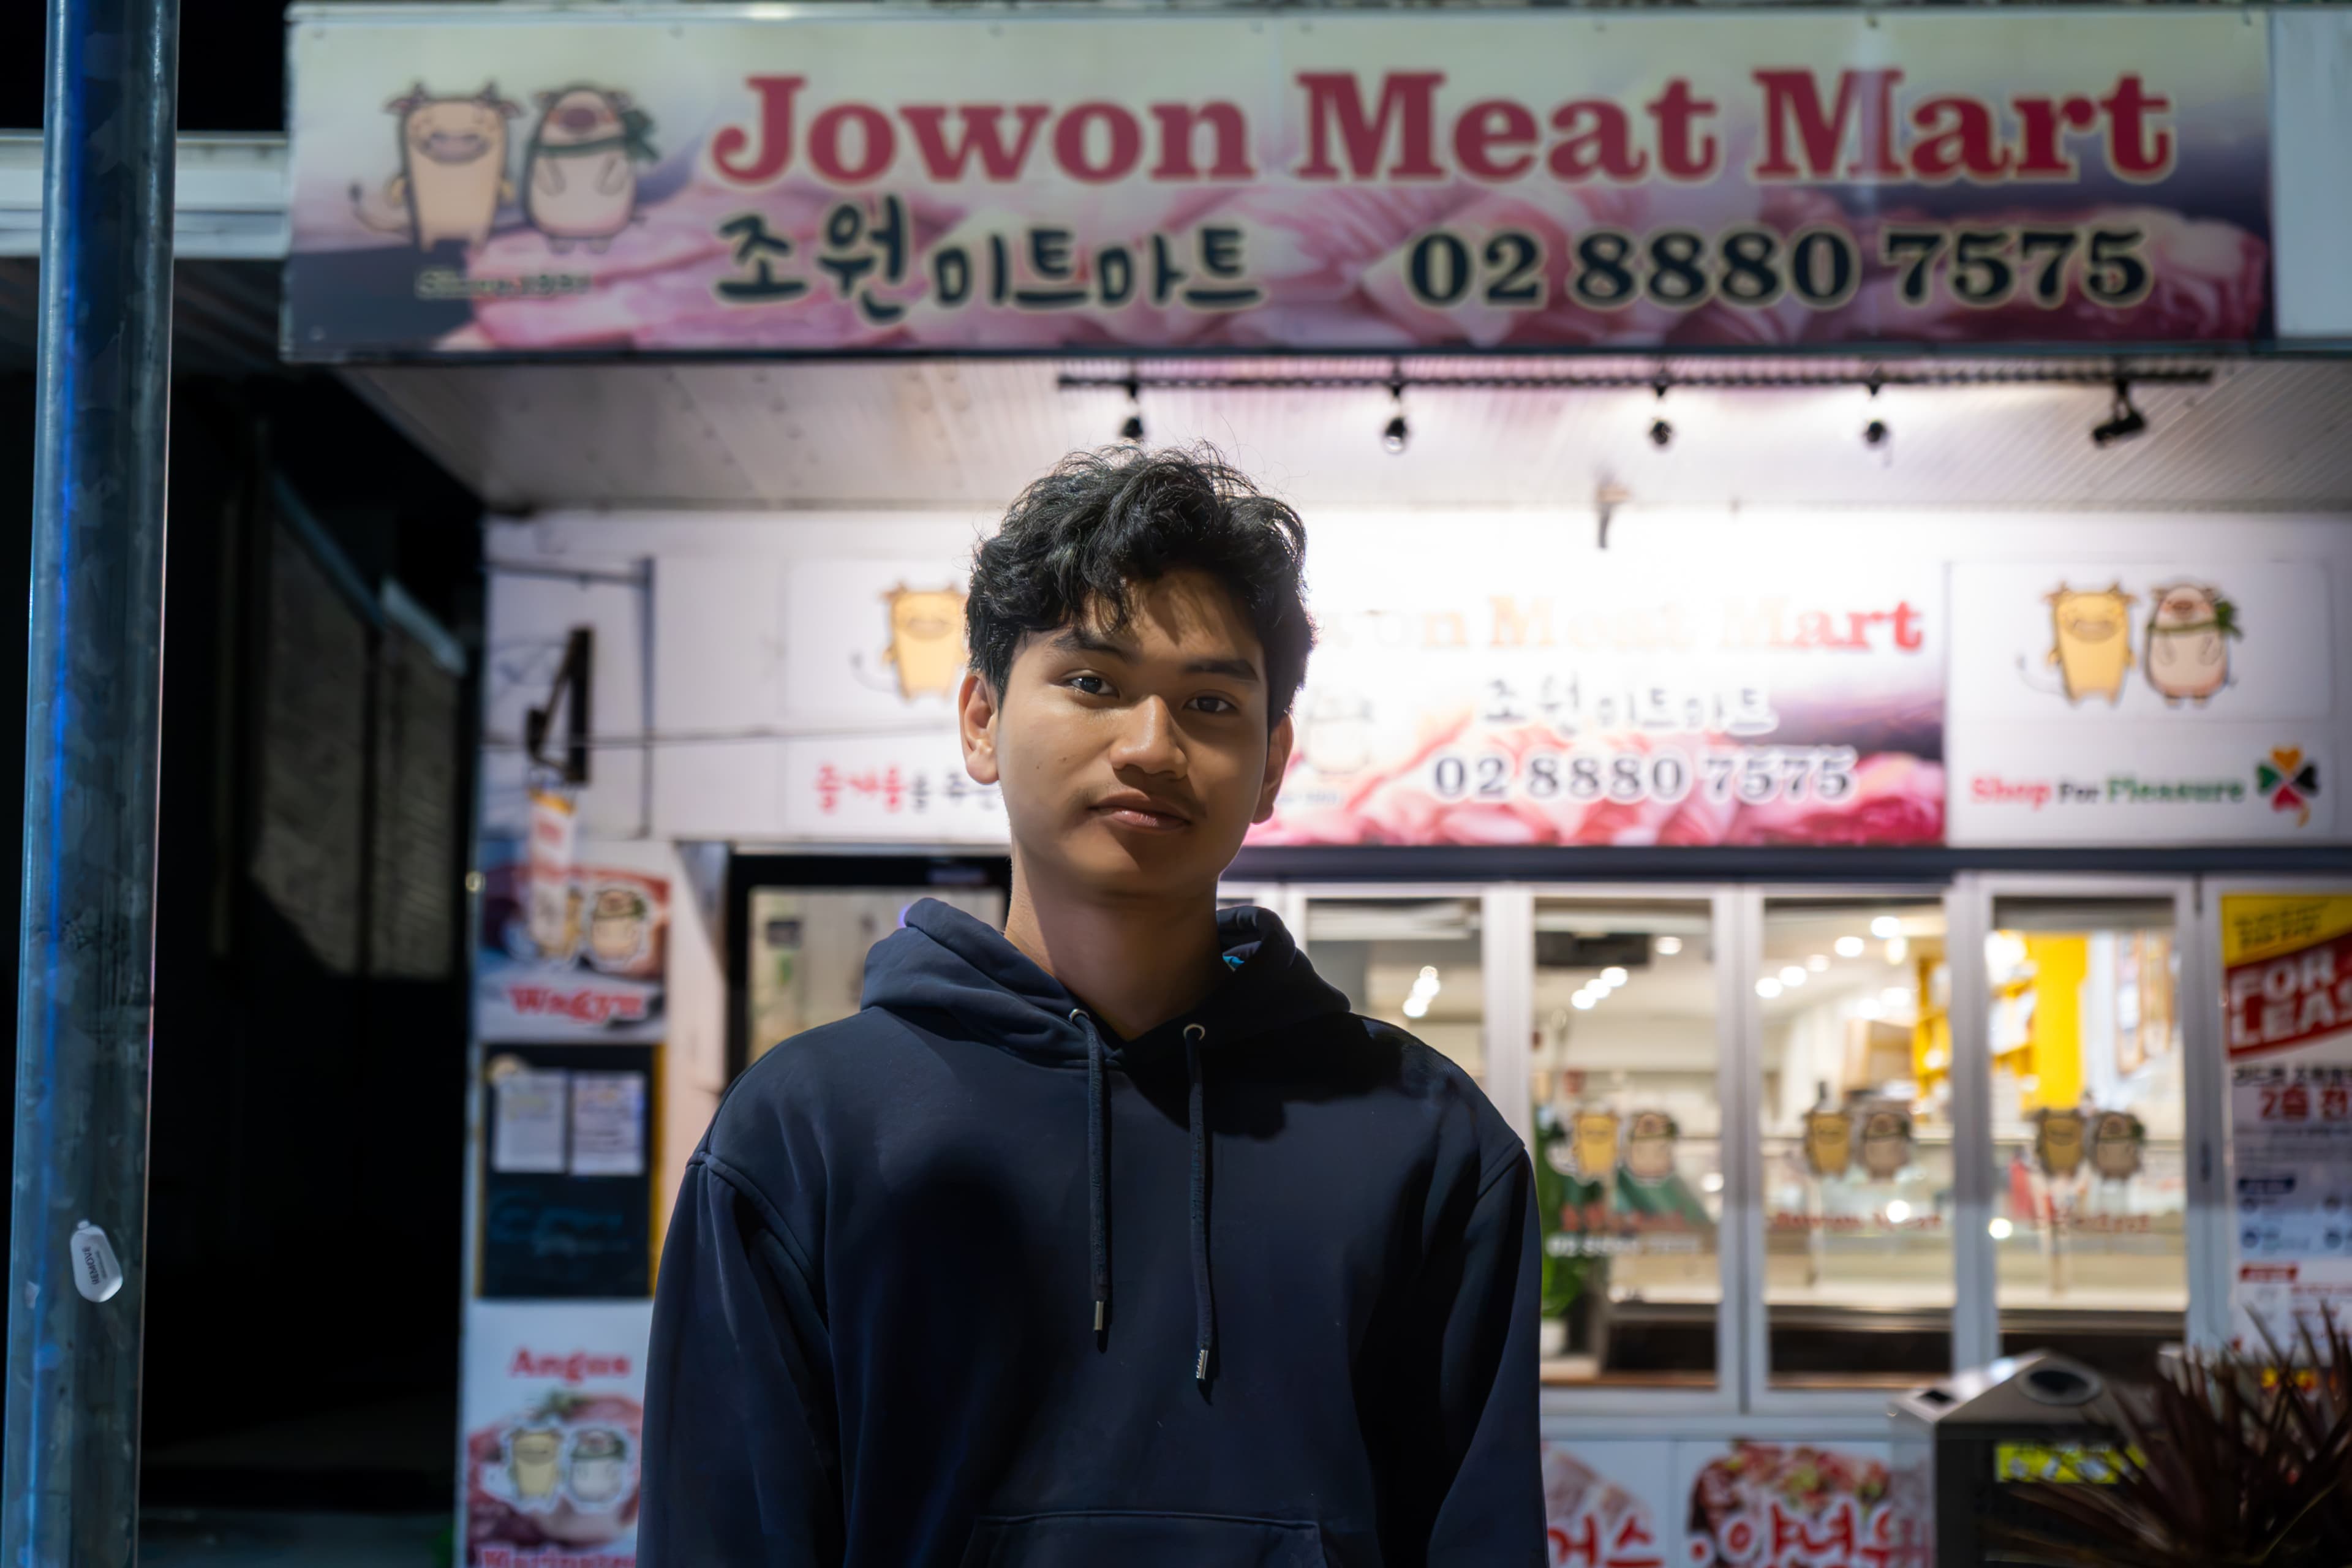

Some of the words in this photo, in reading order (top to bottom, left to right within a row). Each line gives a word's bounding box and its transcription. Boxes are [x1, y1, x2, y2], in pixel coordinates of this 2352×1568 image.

[710, 74, 1257, 185] Jowon
[1294, 70, 1719, 183] Meat
[1752, 67, 2173, 182] Mart
[1409, 230, 1542, 304] 02
[1572, 230, 1852, 306] 8880
[1883, 227, 2149, 306] 7575
[1719, 595, 1928, 654] Mart
[1434, 755, 1507, 799] 02
[1527, 755, 1685, 799] 8880
[1705, 755, 1853, 799] 7575
[1970, 775, 2052, 809] Shop
[2059, 783, 2100, 802] For
[2107, 774, 2245, 803] Pleasure
[507, 984, 646, 1025] Wagyu
[2231, 950, 2335, 1014] FOR
[510, 1348, 631, 1384] Angus
